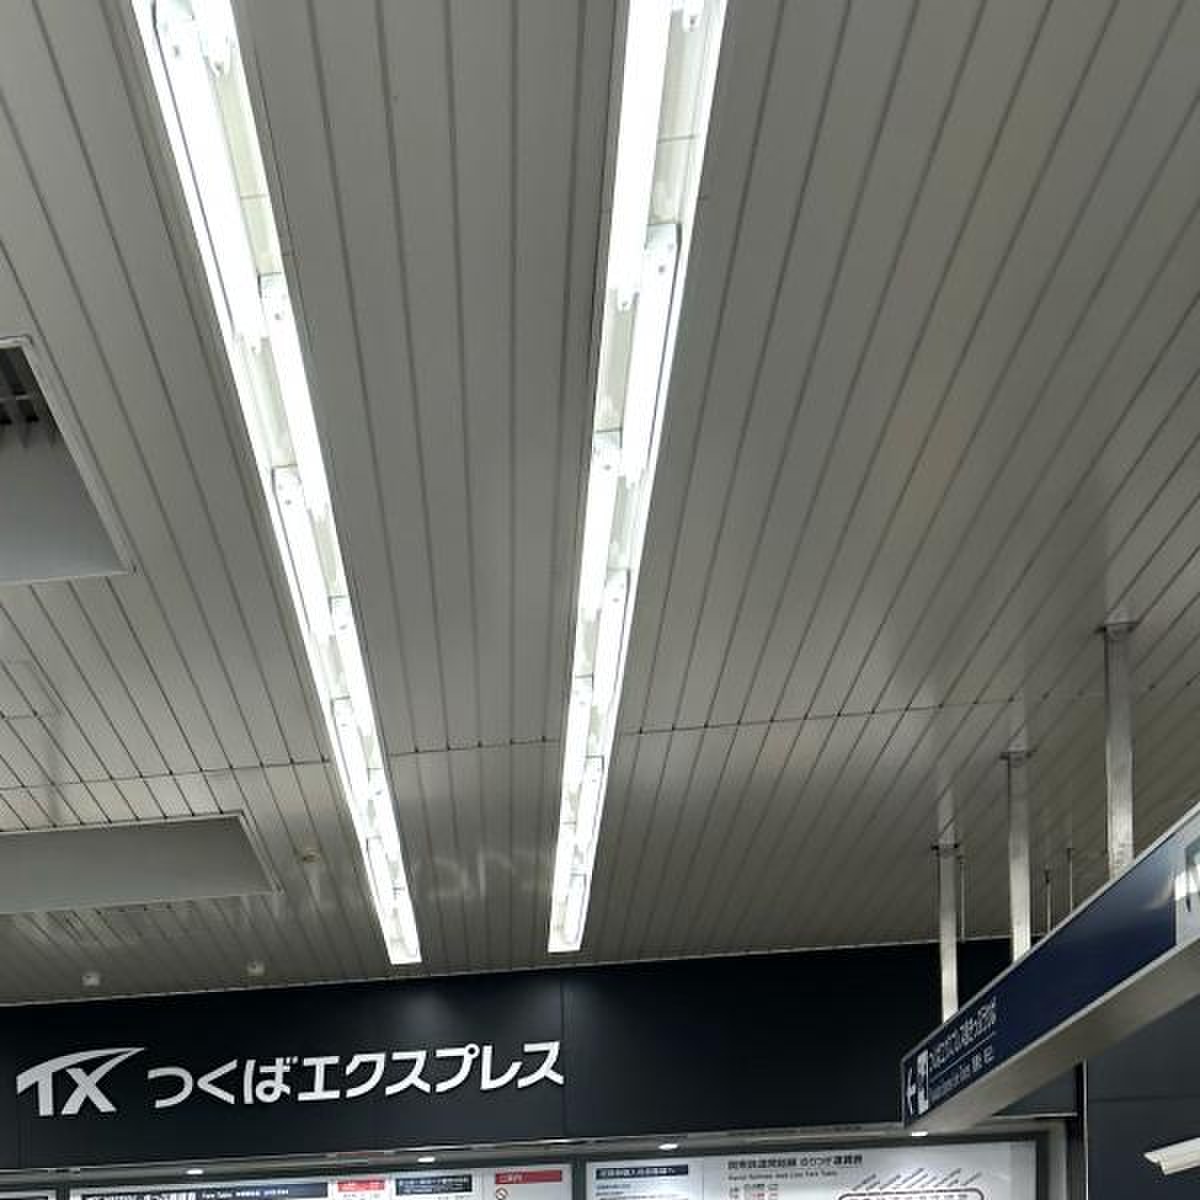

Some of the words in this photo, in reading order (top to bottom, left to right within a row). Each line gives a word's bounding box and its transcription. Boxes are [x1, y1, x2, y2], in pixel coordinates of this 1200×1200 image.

[15, 1046, 145, 1117] TX
[147, 1041, 565, 1108] つくばエクスプレス
